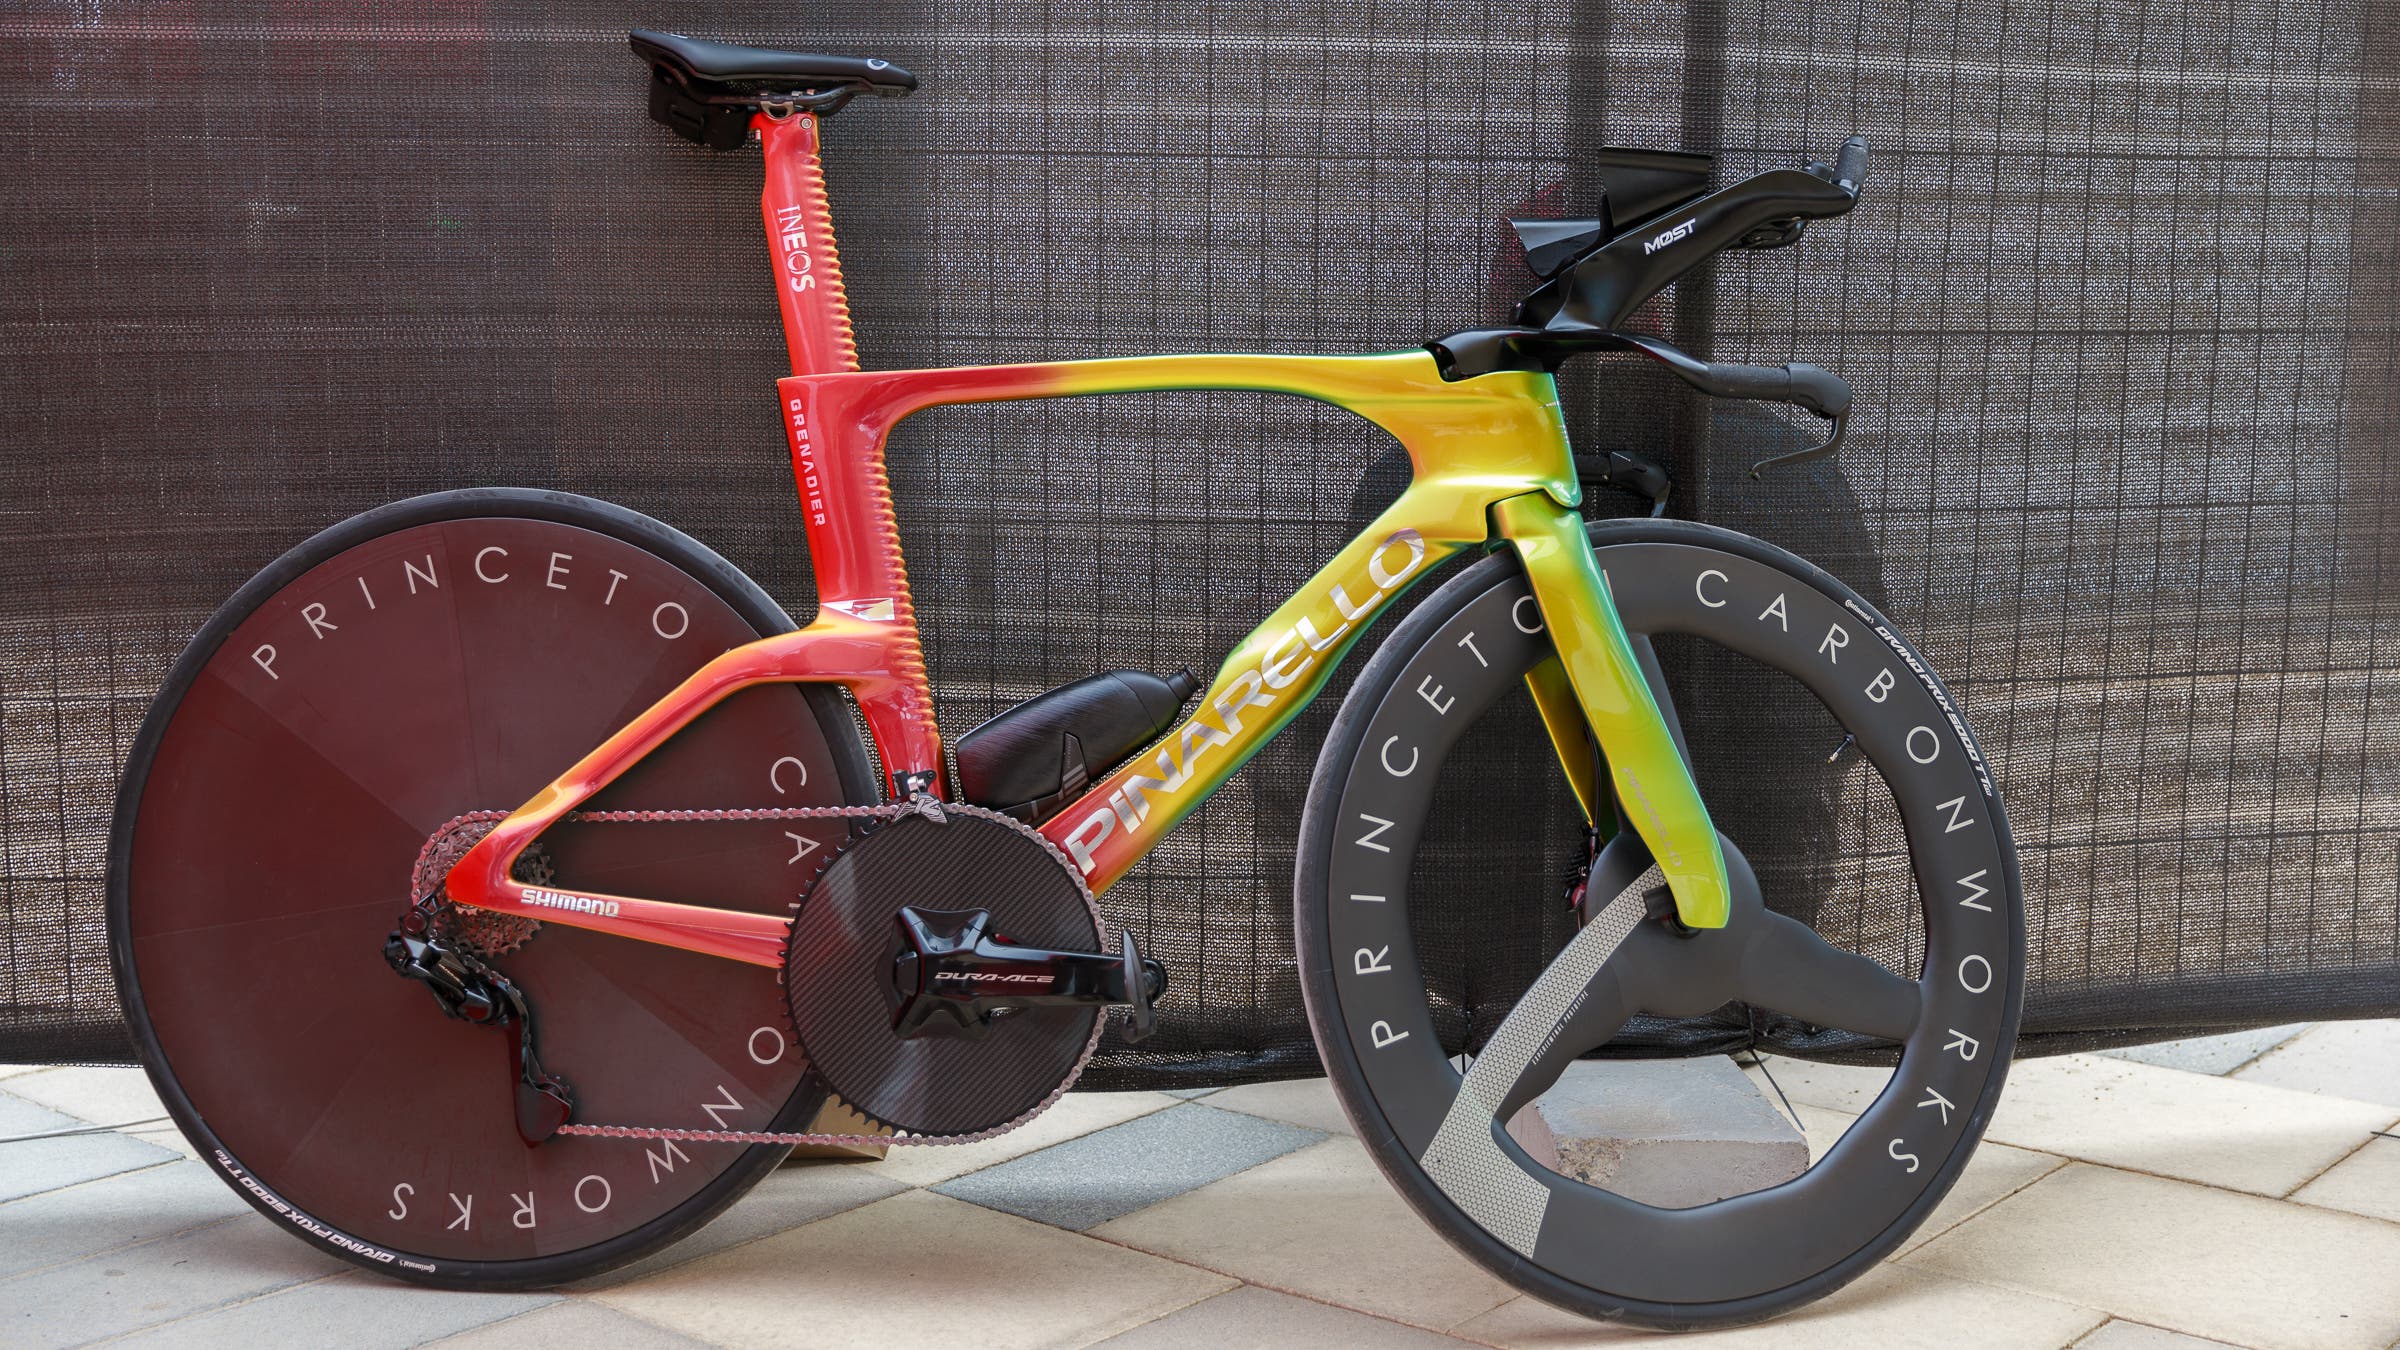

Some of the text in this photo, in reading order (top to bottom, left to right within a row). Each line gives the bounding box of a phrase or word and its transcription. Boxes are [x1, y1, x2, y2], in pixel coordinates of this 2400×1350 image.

[777, 204, 816, 293] INEOS
[789, 398, 826, 527] GRENADIER
[251, 546, 690, 681] PRINCETO
[1064, 527, 1425, 876] PINARELLO
[1845, 599, 1872, 623] Continental
[1874, 626, 1926, 674] GRAND
[1919, 673, 1954, 713] PRIX
[1946, 713, 1981, 762] 5000
[1350, 568, 1993, 1174] PRINCETO CARBONWORKS
[520, 888, 620, 918] SHIMANO
[934, 971, 1056, 984] DURA-ACE
[239, 1176, 291, 1214] 5000
[284, 1210, 332, 1239] PRIX
[327, 1233, 396, 1264] GRAND
[402, 1260, 437, 1274] Continental
